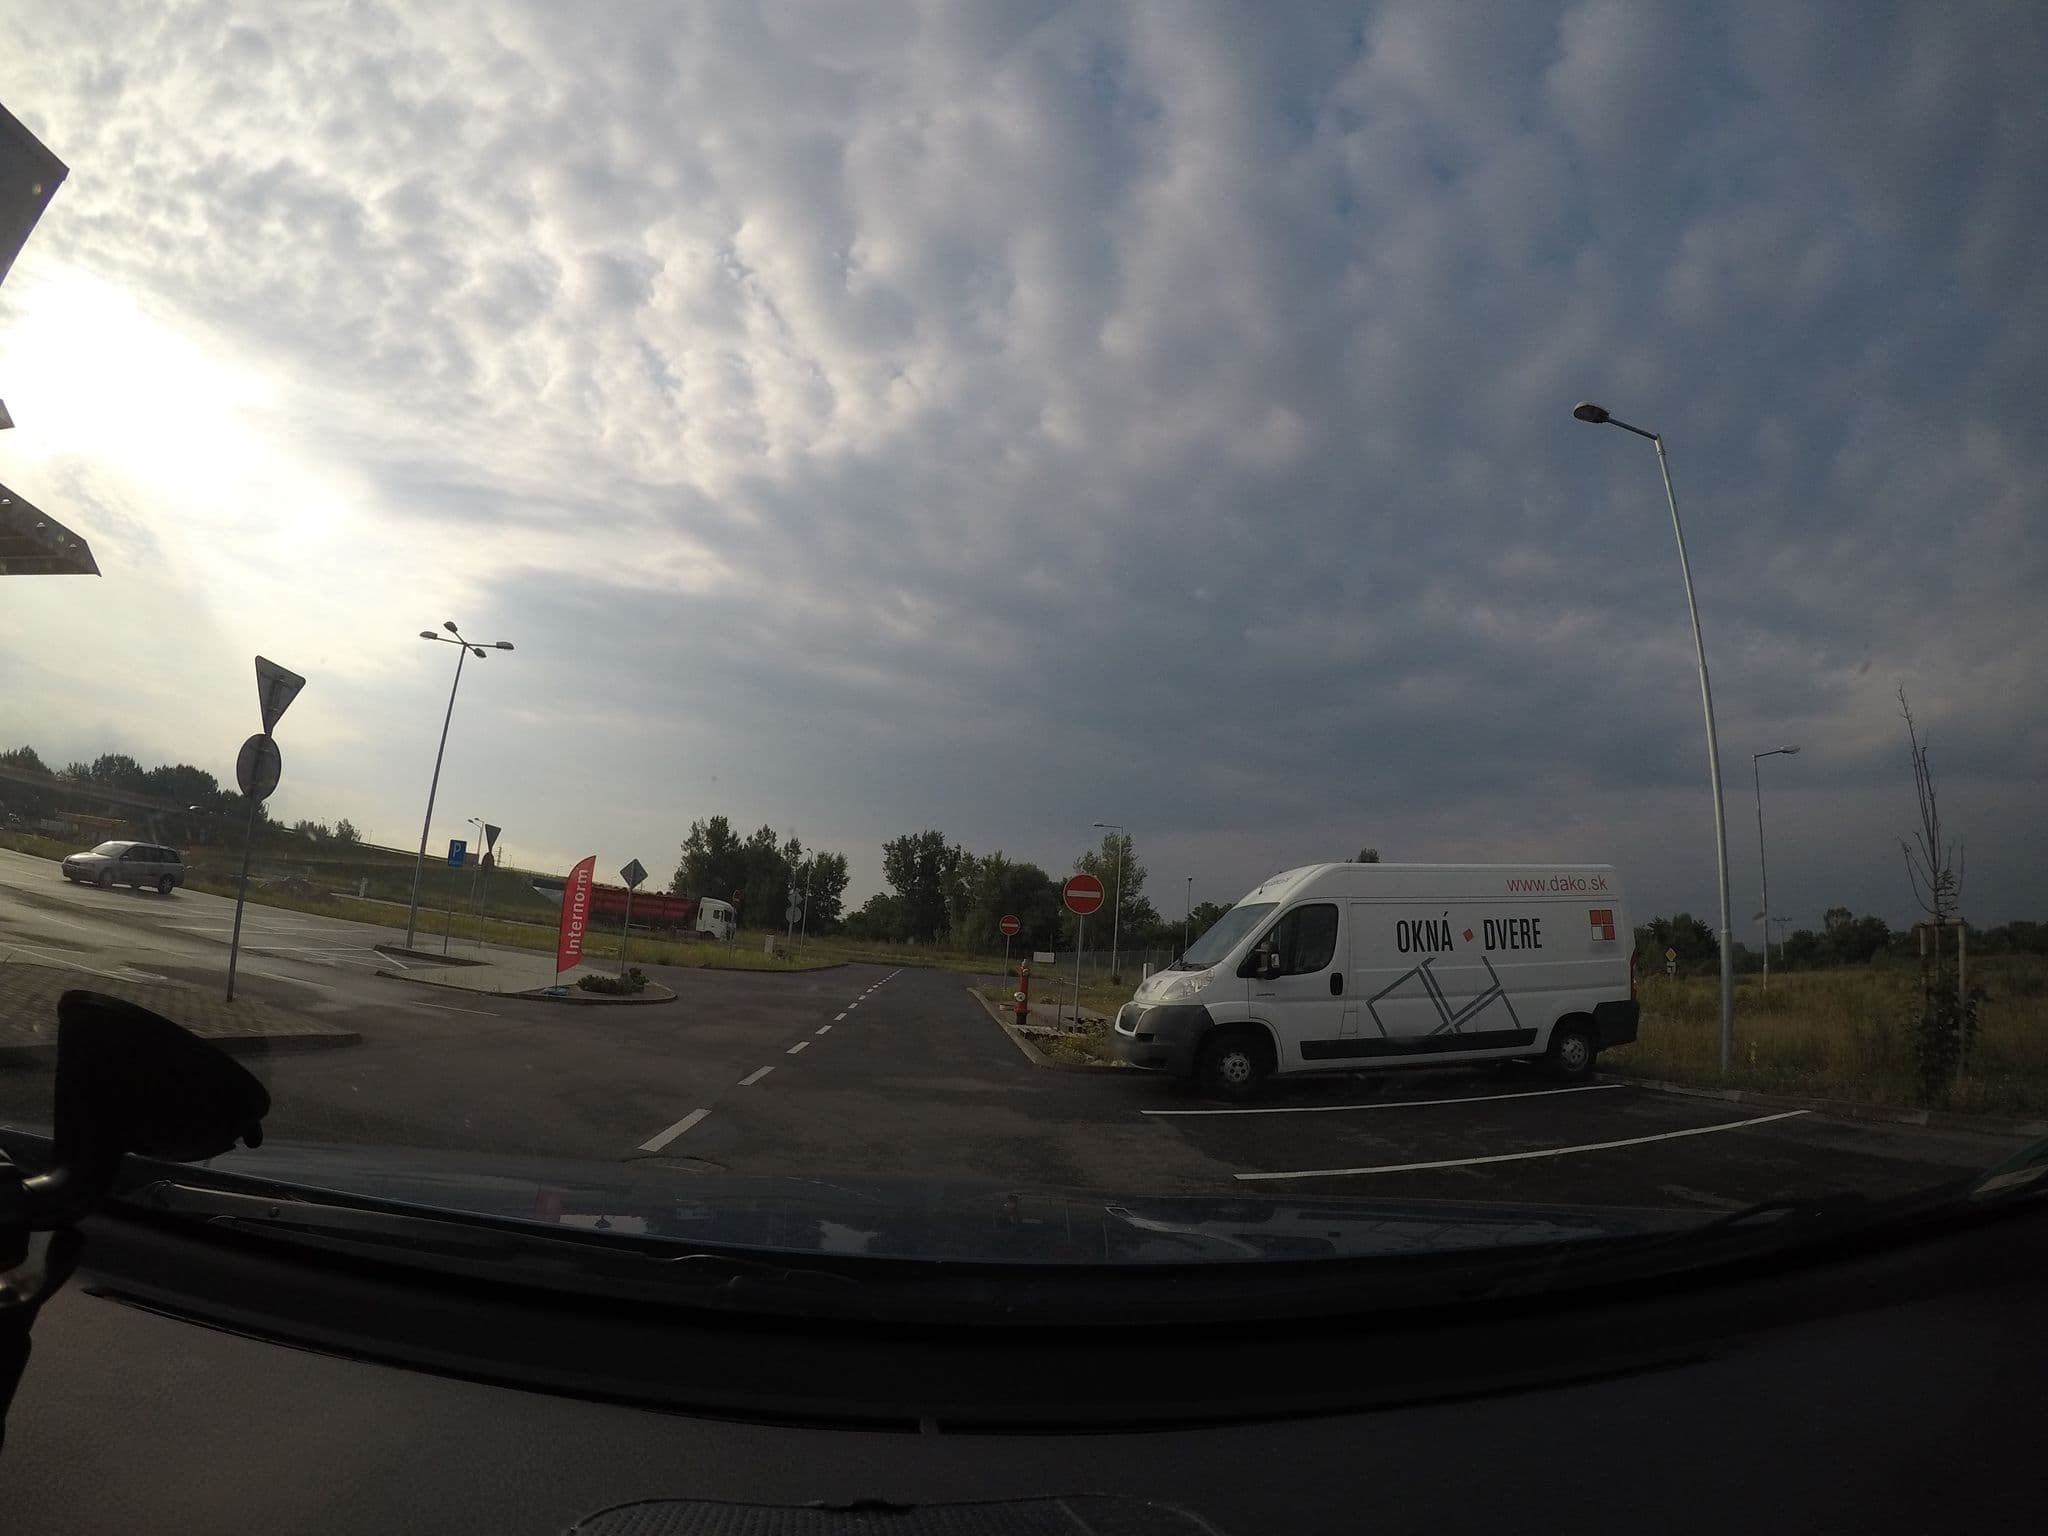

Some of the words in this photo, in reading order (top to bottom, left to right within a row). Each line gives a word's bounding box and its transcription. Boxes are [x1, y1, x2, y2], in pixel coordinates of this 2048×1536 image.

[1507, 875, 1609, 892] www.dako.sk
[566, 869, 588, 955] Internorm
[1396, 911, 1454, 953] OKNÁ
[1483, 918, 1543, 951] DVERE
